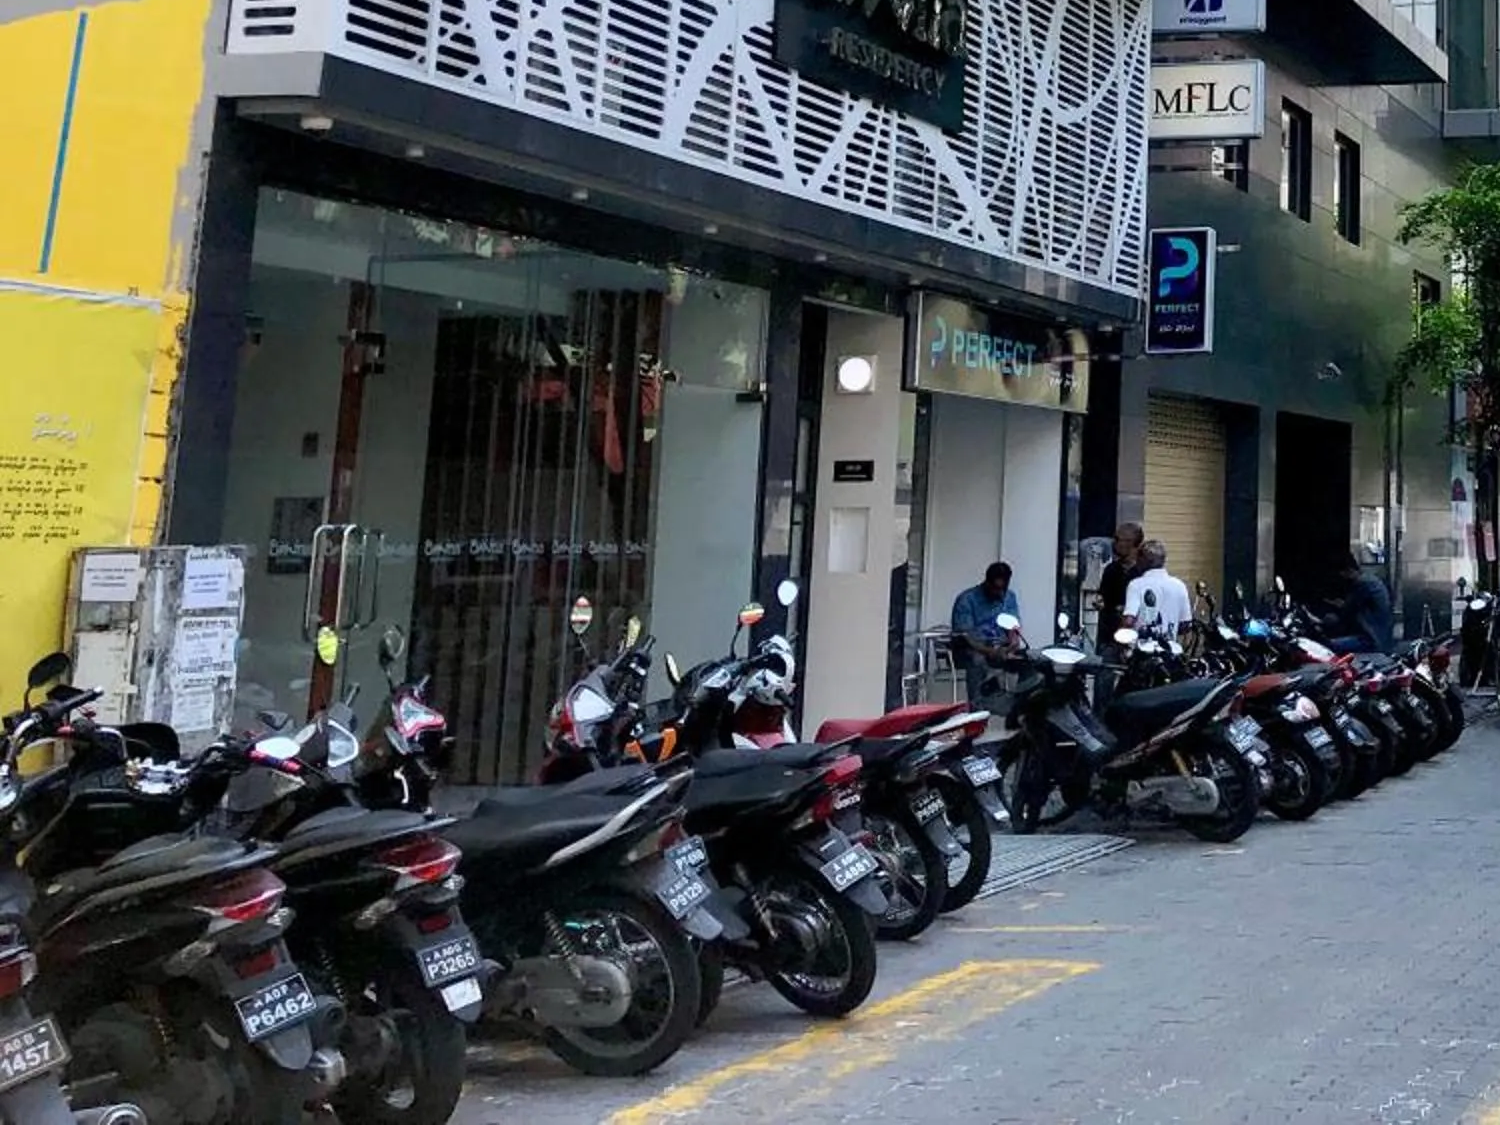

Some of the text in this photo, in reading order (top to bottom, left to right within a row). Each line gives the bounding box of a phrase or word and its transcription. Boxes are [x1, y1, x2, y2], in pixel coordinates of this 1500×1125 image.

[1153, 82, 1251, 115] MFLC
[1154, 302, 1200, 314] PERFECT
[951, 329, 1037, 378] PERFECT
[427, 951, 475, 979] P3265
[247, 992, 313, 1033] P6462
